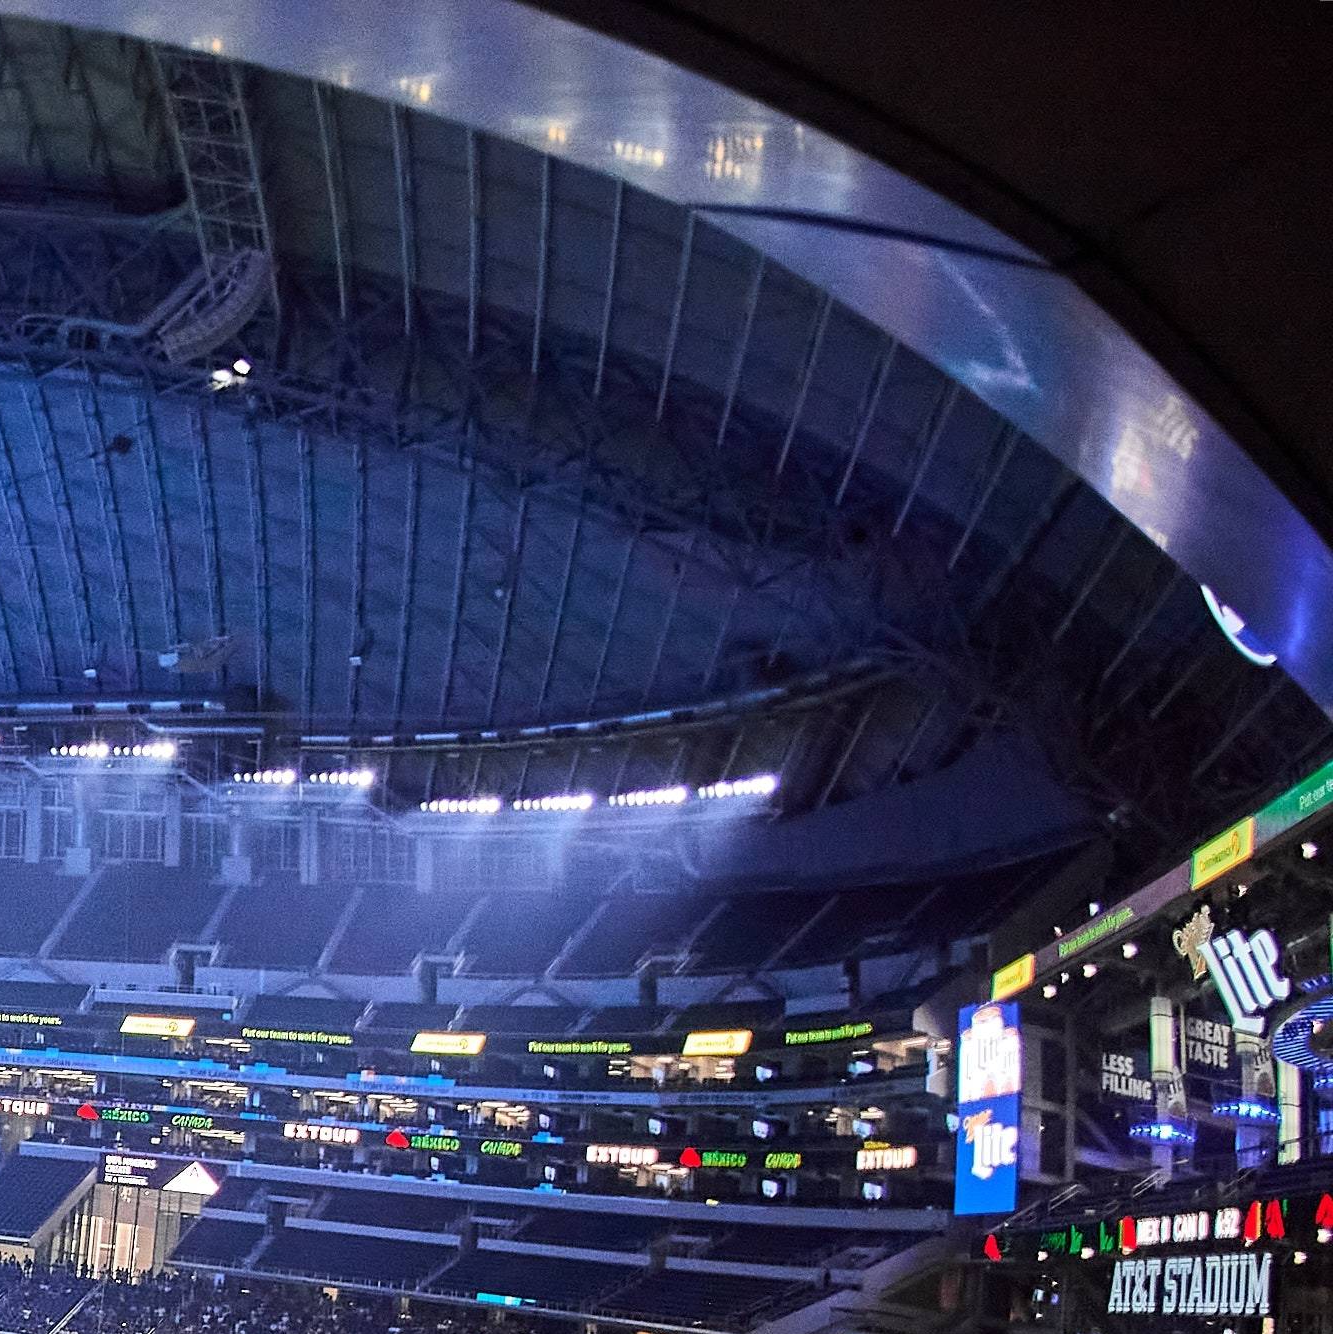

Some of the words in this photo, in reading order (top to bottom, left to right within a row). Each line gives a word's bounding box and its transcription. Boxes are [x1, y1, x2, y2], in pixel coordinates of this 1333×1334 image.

[1187, 1016, 1230, 1046] GREAT
[1102, 1052, 1133, 1076] LESS
[1186, 1040, 1229, 1069] TASTE
[1101, 1074, 1152, 1101] FILLING
[1136, 1217, 1160, 1246] MEX
[1173, 1213, 1198, 1242] CAN
[1108, 1259, 1162, 1313] AT&T
[1163, 1253, 1272, 1315] STADIUM
